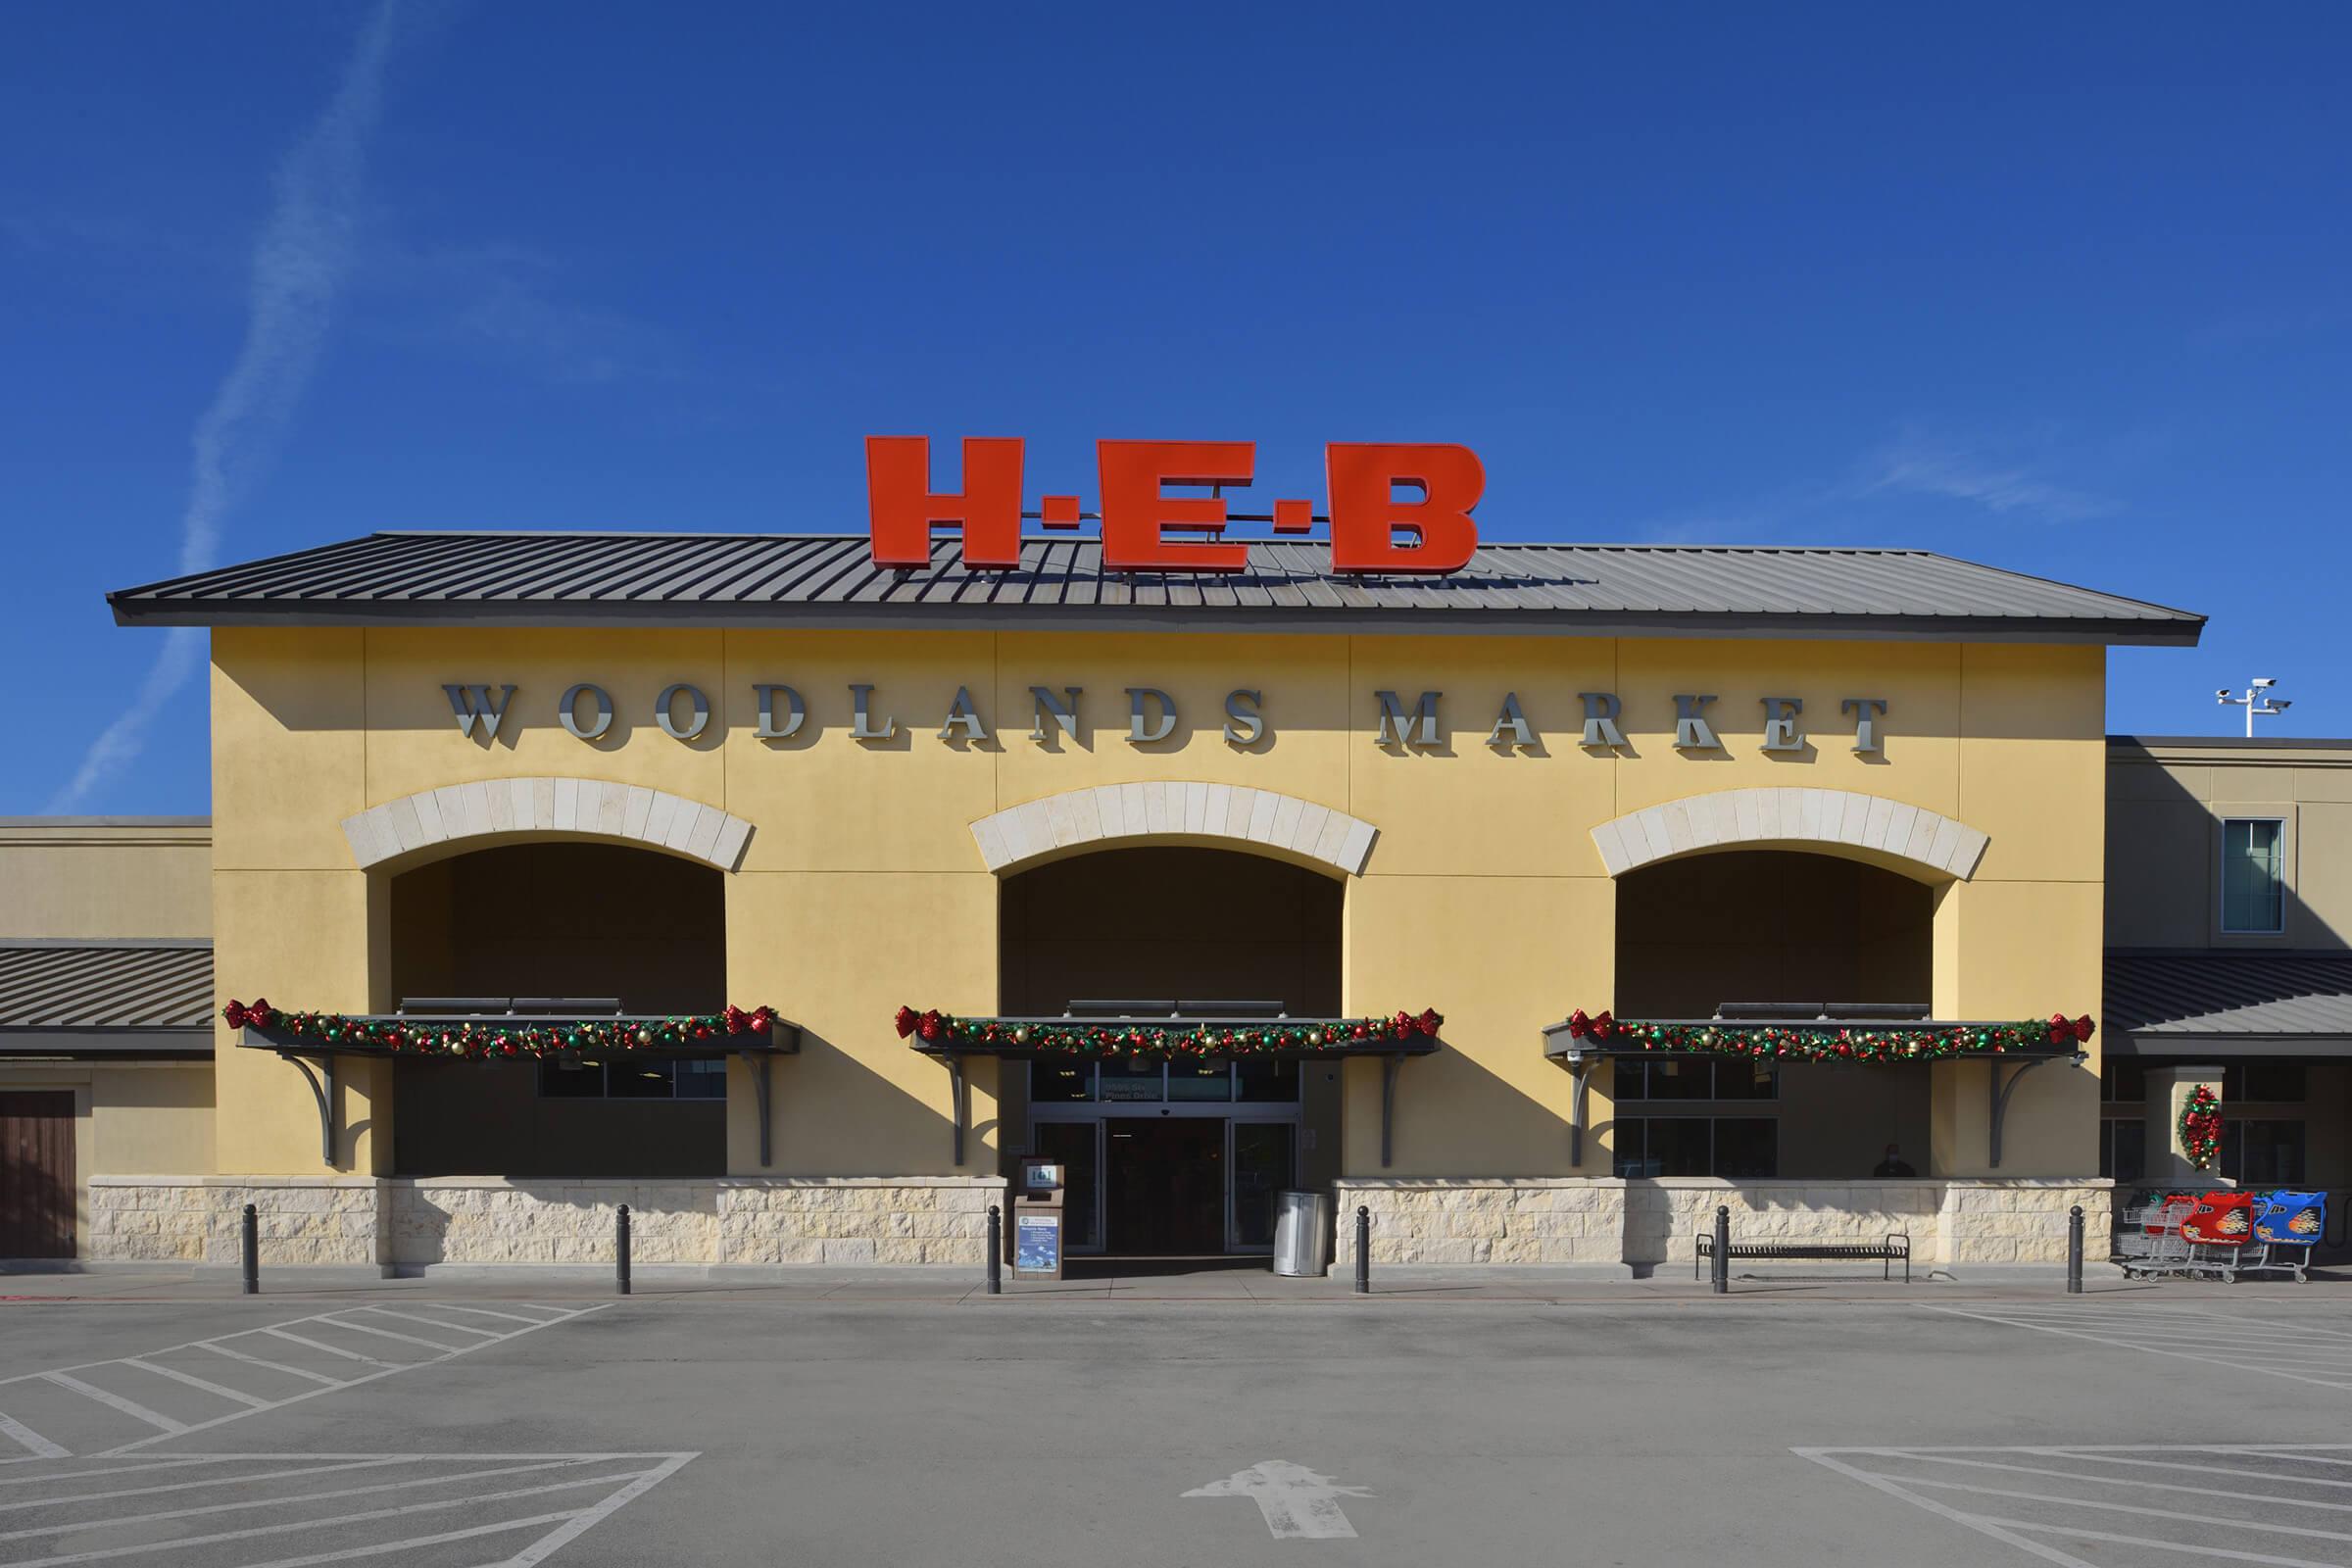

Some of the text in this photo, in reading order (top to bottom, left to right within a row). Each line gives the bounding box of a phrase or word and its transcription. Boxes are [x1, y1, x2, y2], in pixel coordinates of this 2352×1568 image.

[866, 435, 1487, 574] H-E-B
[441, 683, 1887, 753] WOODLANDS MARKET
